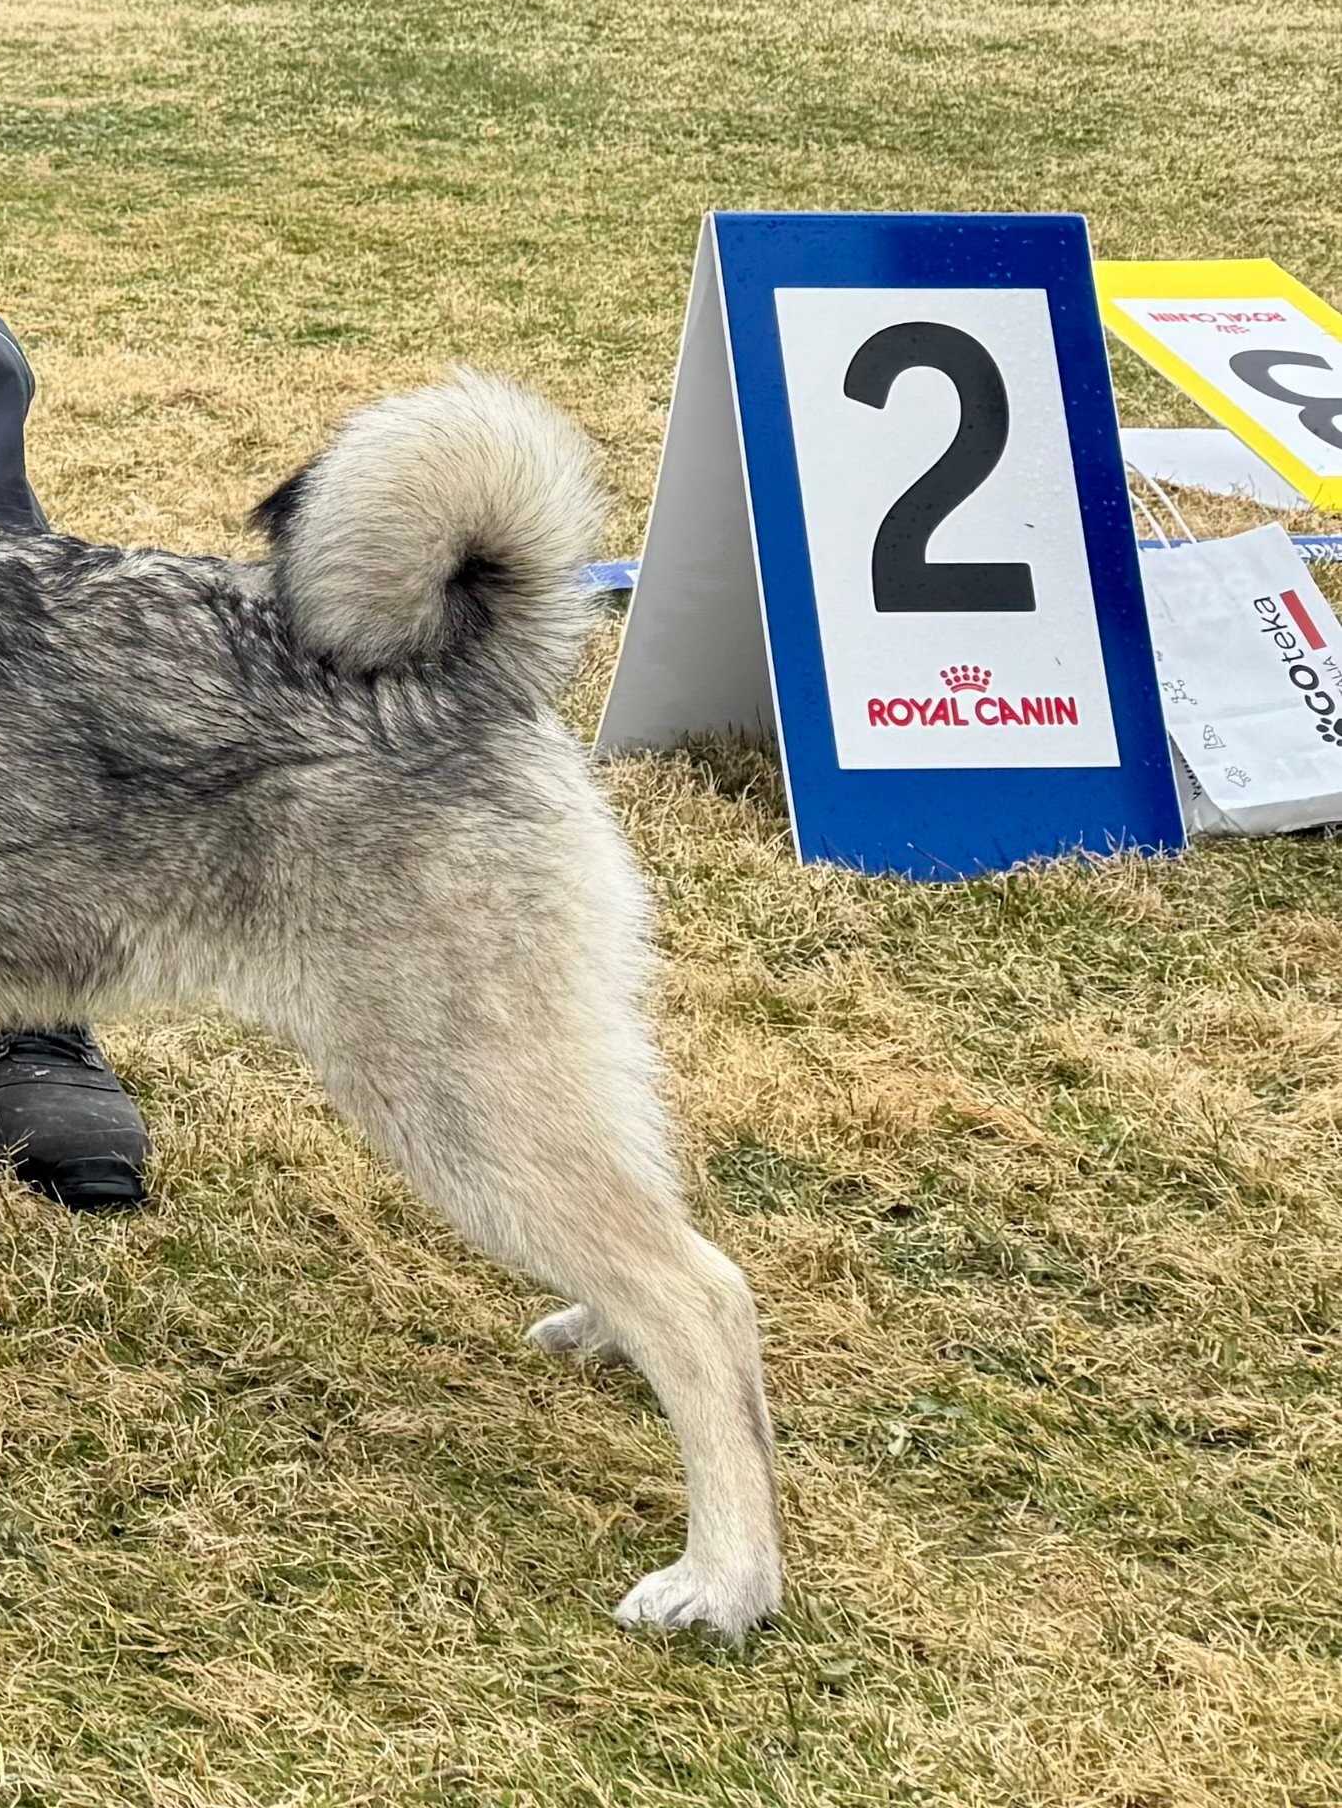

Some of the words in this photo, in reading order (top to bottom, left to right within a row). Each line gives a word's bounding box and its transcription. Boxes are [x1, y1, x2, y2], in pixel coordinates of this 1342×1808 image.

[843, 321, 1037, 613] 2
[867, 697, 969, 727] ROYAL
[975, 696, 1079, 726] CANIN
